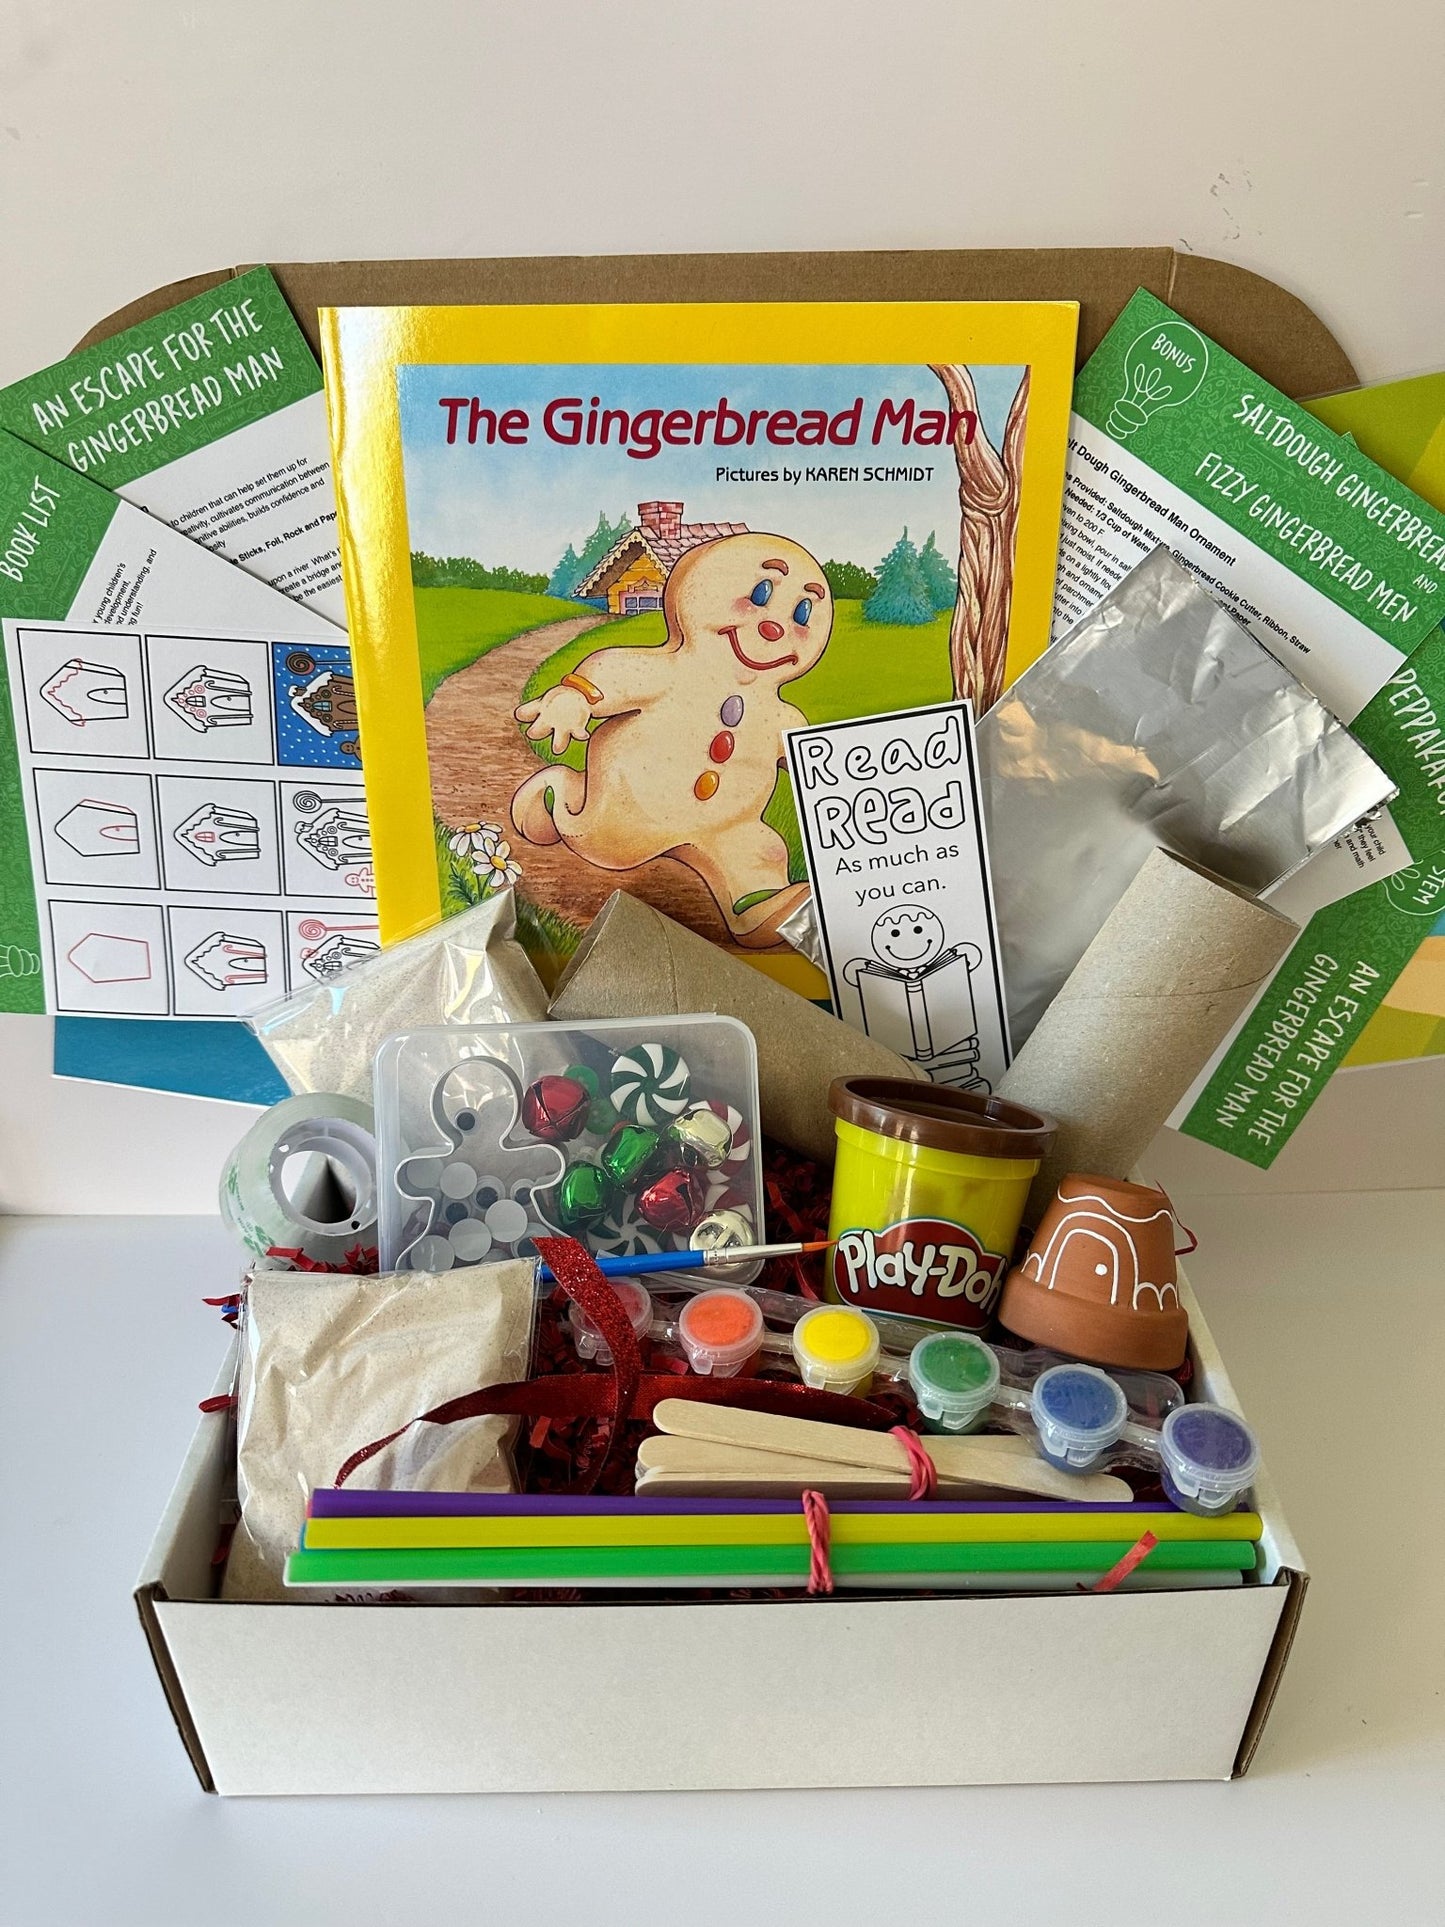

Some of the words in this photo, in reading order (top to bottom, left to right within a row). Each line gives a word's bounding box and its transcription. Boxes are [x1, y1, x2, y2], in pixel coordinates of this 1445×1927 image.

[32, 394, 70, 435] AN
[70, 346, 164, 414] ESCAPE
[162, 323, 213, 370] FOR
[209, 299, 263, 344] THE
[1151, 333, 1196, 373] BONUS
[68, 376, 222, 472] GINGERBREAD
[223, 346, 284, 396] MAN
[439, 397, 529, 445] The
[542, 397, 864, 459] Gingerbread
[871, 398, 977, 446] Man
[1233, 394, 1344, 485] SALTDOUGH
[180, 505, 209, 523] children
[208, 497, 224, 509] that
[223, 491, 238, 502] can
[237, 483, 255, 495] help
[255, 476, 267, 487] set
[266, 468, 287, 481] them
[286, 463, 297, 472] up
[296, 458, 308, 467] for
[210, 502, 244, 523] cultivates
[244, 477, 299, 507] communication
[297, 462, 330, 481] between
[715, 466, 779, 483] Pictures
[782, 466, 802, 485] by
[805, 467, 860, 482] KAREN
[863, 466, 935, 482] SCHMIDT
[218, 516, 249, 534] abilities,
[247, 504, 270, 519] builds
[270, 485, 310, 509] confidence
[310, 477, 325, 490] and
[1064, 488, 1095, 513] Needed:
[1095, 509, 1107, 521] 1/3
[1106, 518, 1122, 533] Cup
[1121, 530, 1130, 539] of
[1076, 445, 1109, 474] Dough
[1110, 469, 1169, 518] Gingerbread
[1168, 511, 1189, 532] Man
[1189, 528, 1237, 567] Ornament
[1076, 514, 1084, 523] to
[1083, 519, 1098, 533] 200
[0, 522, 40, 583] BOOK
[22, 475, 61, 528] LIST
[238, 546, 266, 562] Sticks,
[265, 537, 284, 550] Foil,
[282, 527, 305, 541] Rock
[304, 518, 320, 531] and
[1077, 530, 1096, 549] bowl,
[1095, 544, 1112, 561] pour
[1111, 554, 1119, 564] in
[1195, 452, 1259, 504] FIZZY
[1249, 494, 1373, 591] GINGERBREAD
[1367, 580, 1418, 623] MEN
[268, 573, 287, 587] upon
[311, 549, 337, 566] What's
[1061, 534, 1079, 549] just
[1095, 558, 1103, 567] If
[1065, 554, 1077, 565] on
[1081, 564, 1101, 583] lightly
[1072, 477, 1108, 506] Provided:
[1107, 502, 1144, 532] Saltdough
[1172, 549, 1215, 585] Gingerbread
[1215, 581, 1240, 603] Cookie
[1239, 599, 1262, 621] Cutter,
[1262, 615, 1289, 641] Ribbon,
[1289, 635, 1311, 654] Straw
[95, 596, 111, 620] young
[106, 563, 126, 597] children's
[121, 566, 151, 616] understanding,
[146, 548, 157, 564] and
[303, 586, 317, 597] the
[317, 575, 343, 591] easiest
[307, 566, 330, 582] bridge
[1065, 570, 1080, 582] and
[1412, 573, 1438, 593] AND
[132, 602, 144, 617] fun!
[1062, 614, 1075, 625] the
[1068, 602, 1083, 615] into
[798, 715, 961, 789] Read
[835, 856, 862, 876] As
[868, 843, 929, 870] much
[936, 843, 960, 860] as
[1346, 838, 1357, 852] and
[1352, 850, 1366, 869] math
[1358, 834, 1368, 850] they
[1365, 847, 1376, 862] feel
[1373, 840, 1386, 855] child
[855, 885, 895, 907] you
[902, 876, 946, 895] can.
[1349, 960, 1380, 995] AN
[1245, 953, 1339, 1082] GINGERBREAD
[1296, 995, 1360, 1072] ESCAPE
[1216, 1082, 1259, 1129] MAN
[1271, 1068, 1312, 1109] FOR
[1247, 1109, 1287, 1146] THE
[838, 1230, 1007, 1316] Play-Doh
